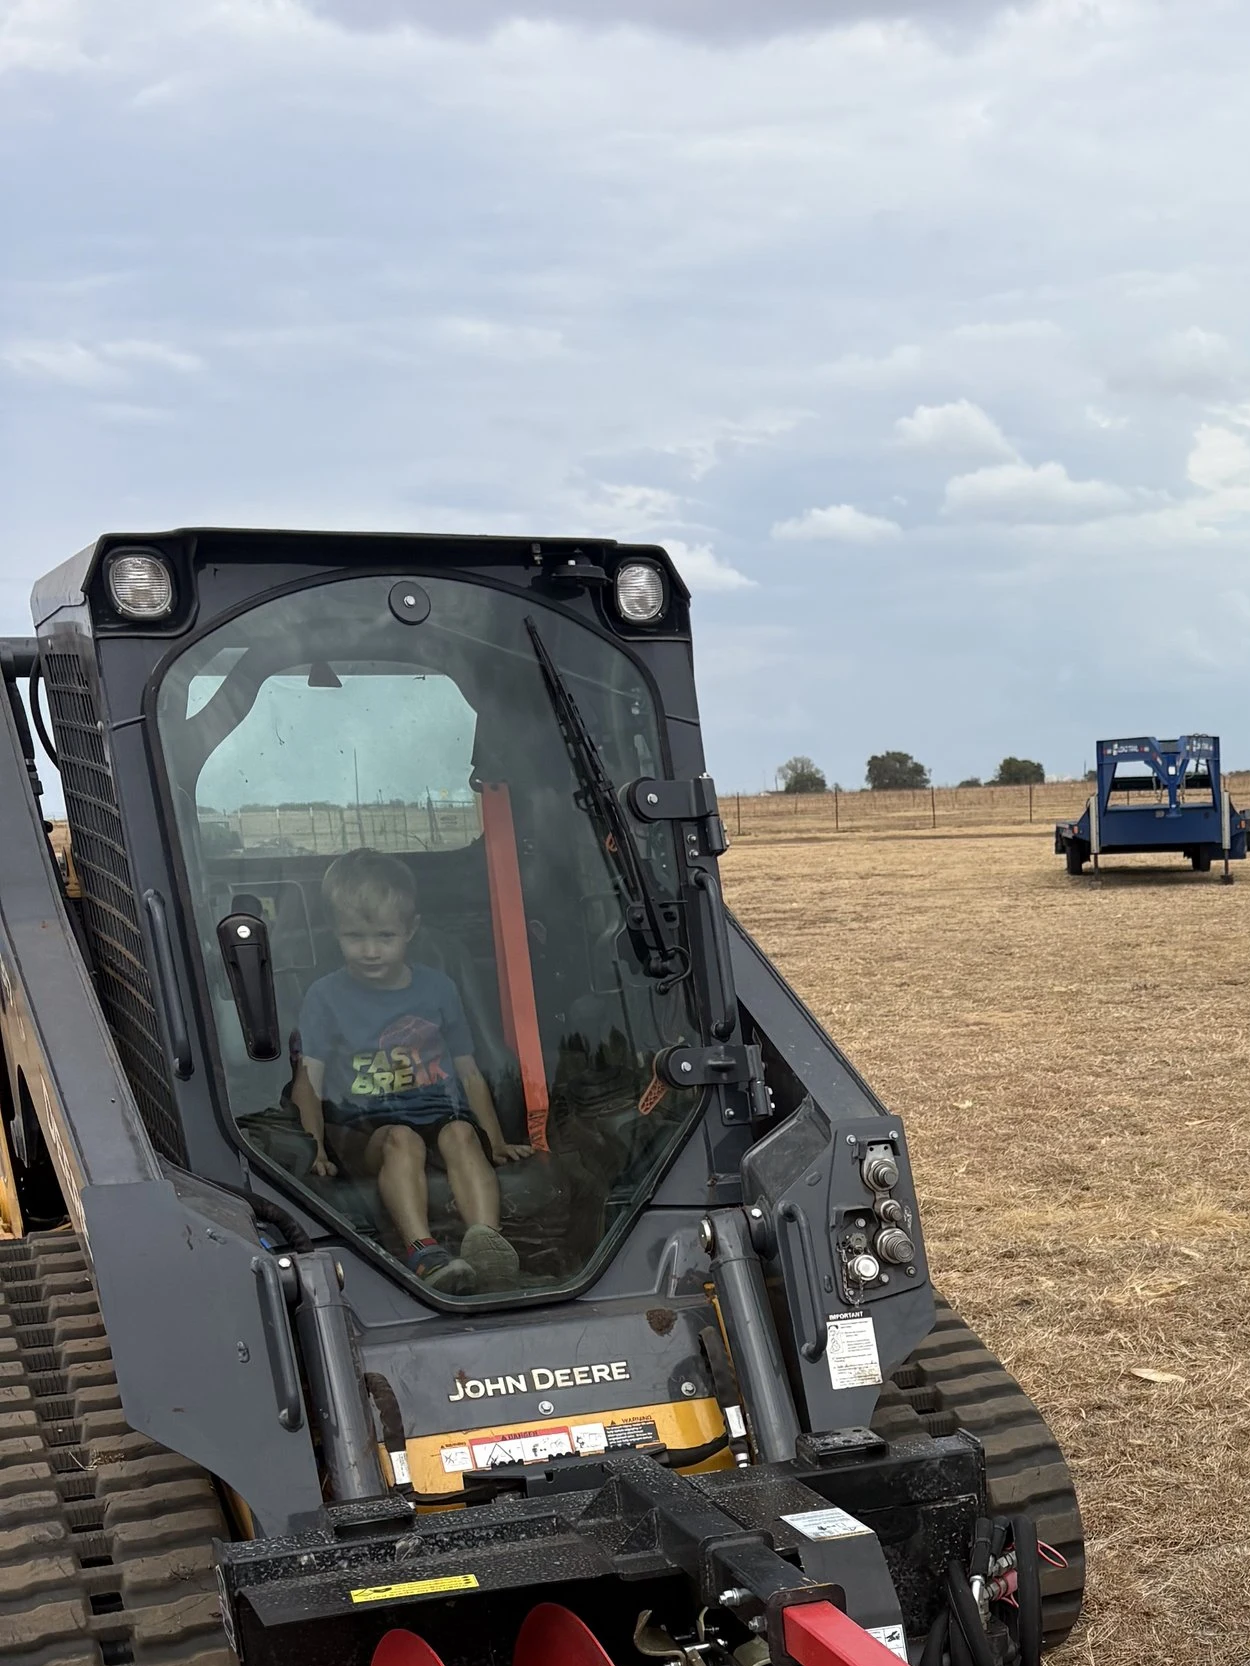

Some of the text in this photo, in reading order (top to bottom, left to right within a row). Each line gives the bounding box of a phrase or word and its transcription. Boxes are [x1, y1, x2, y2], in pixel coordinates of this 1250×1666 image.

[828, 1310, 864, 1321] IMPORTANT
[449, 1361, 630, 1402] JOHN DEERE
